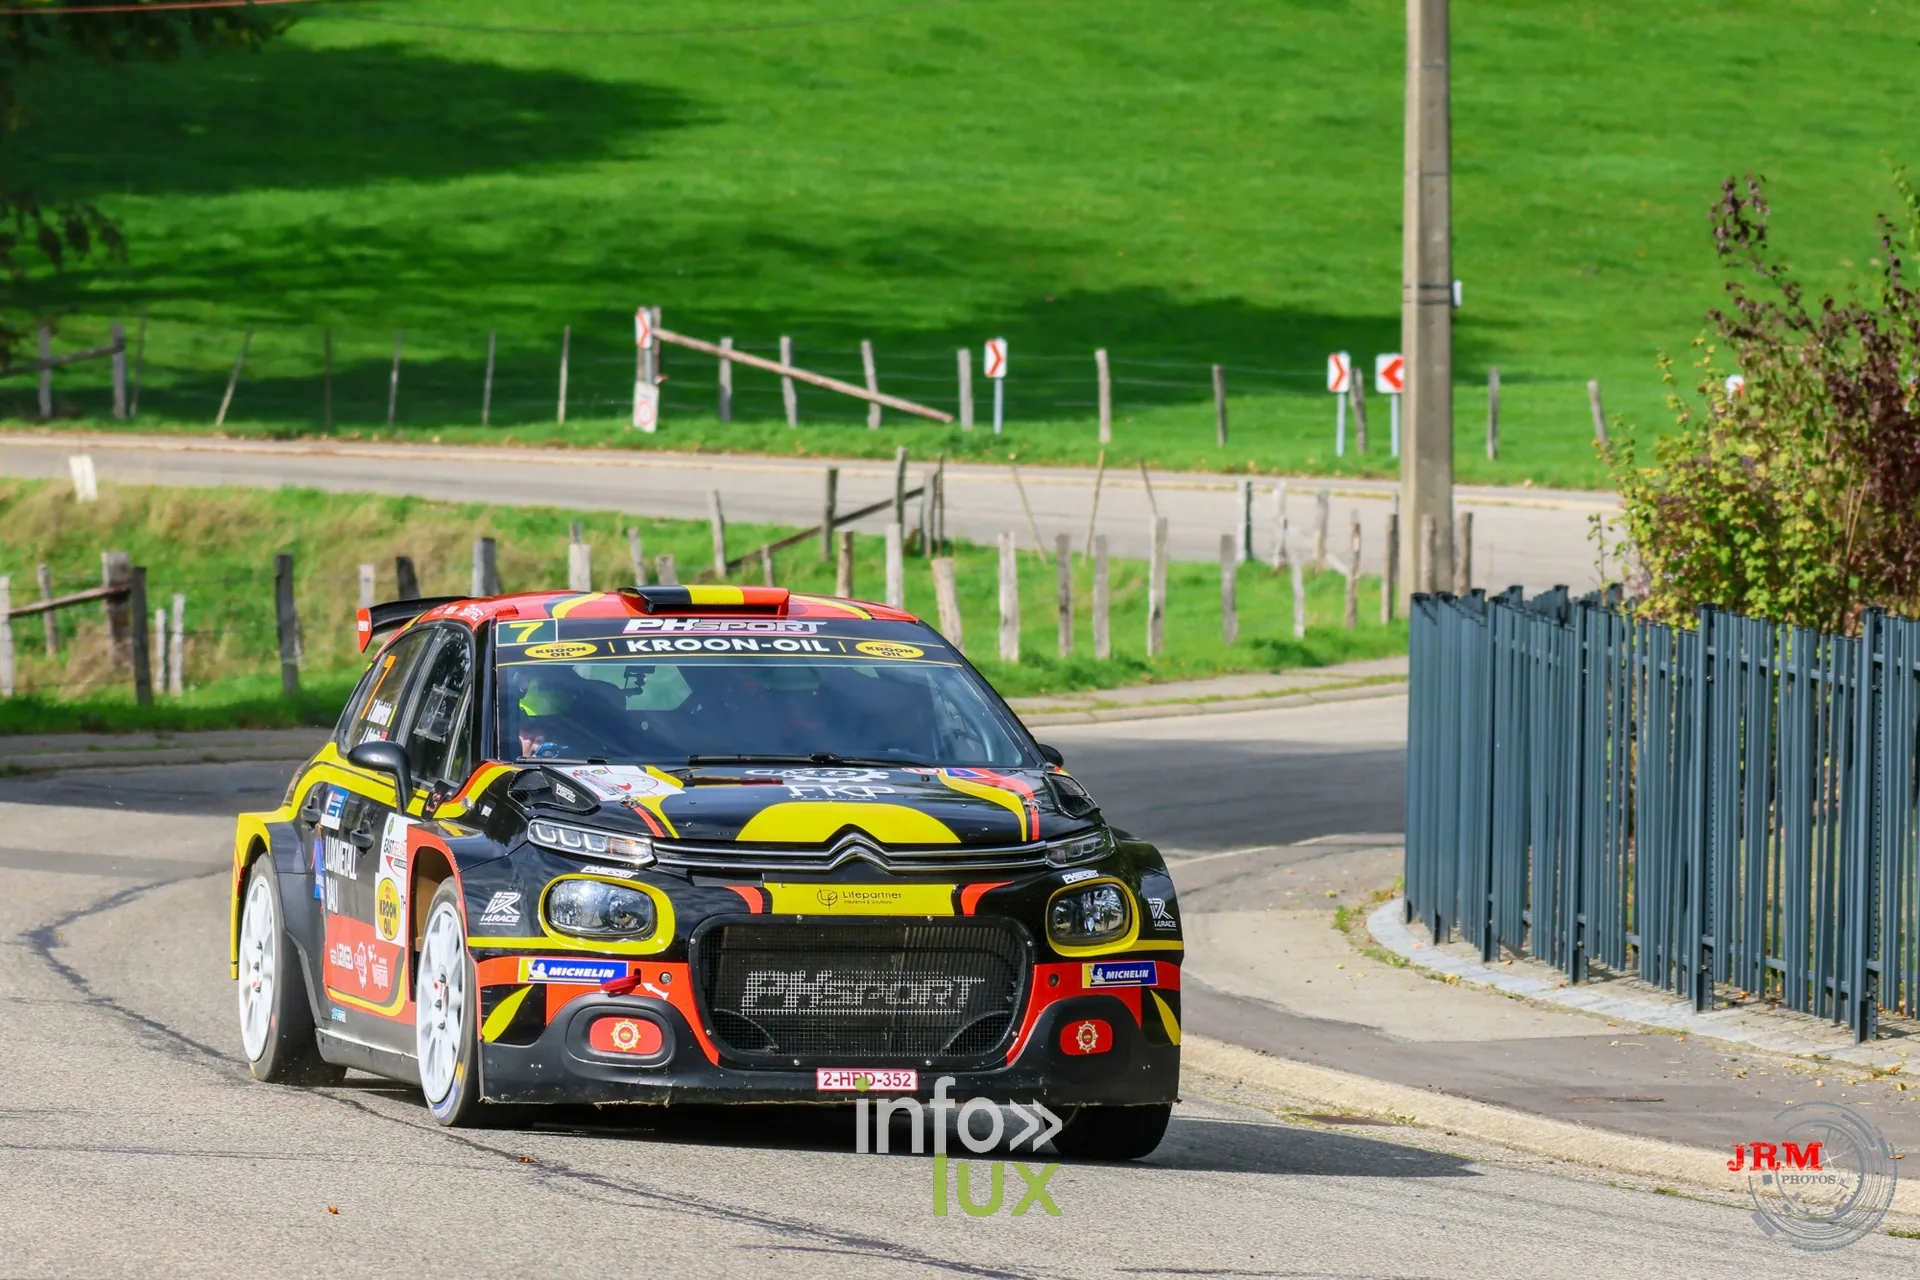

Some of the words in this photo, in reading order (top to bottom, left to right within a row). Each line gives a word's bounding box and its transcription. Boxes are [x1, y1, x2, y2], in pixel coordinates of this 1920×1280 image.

[625, 618, 828, 632] PHSPORT
[509, 622, 544, 643] 7
[535, 646, 587, 654] KROON
[627, 638, 830, 652] KROON-OIL
[865, 645, 914, 654] KROON
[842, 891, 902, 900] Lifepartner
[380, 899, 397, 920] KROON
[384, 918, 392, 936] OIL
[548, 966, 616, 978] MICHELIN
[1105, 969, 1150, 980] MICHELIN
